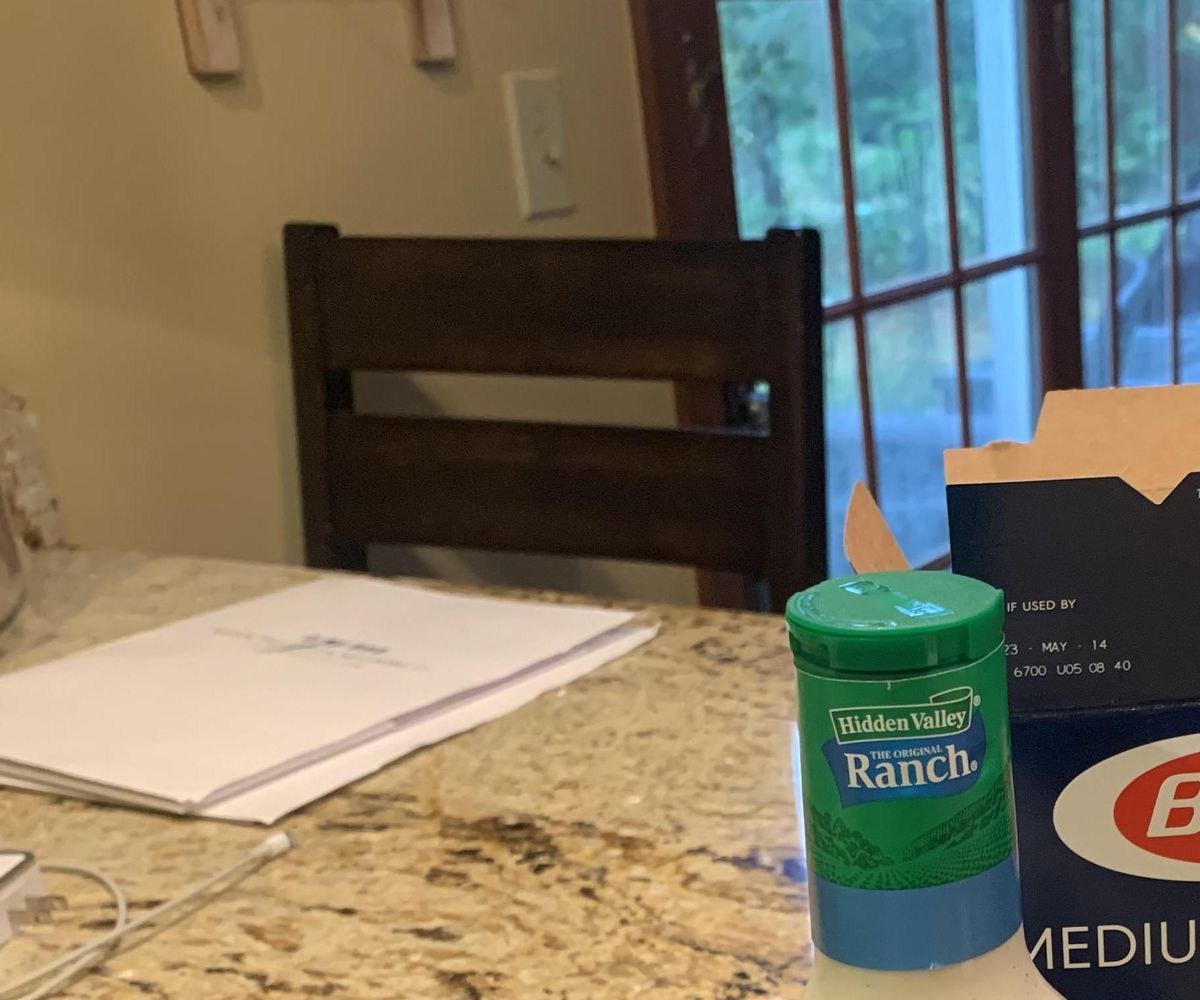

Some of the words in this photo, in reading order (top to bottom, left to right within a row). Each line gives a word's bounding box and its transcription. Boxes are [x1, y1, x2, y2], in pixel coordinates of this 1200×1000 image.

[1006, 602, 1017, 612] IF
[1022, 600, 1056, 612] USED
[1060, 599, 1077, 610] BY
[1004, 643, 1018, 656] 23
[1042, 641, 1068, 654] MAY
[1092, 639, 1107, 651] 14
[1013, 665, 1047, 678] 6700
[838, 712, 909, 736] Hidden
[911, 708, 967, 731] Valley
[870, 750, 892, 761] THE
[893, 744, 943, 759] ORIGINAL
[844, 744, 972, 789] Ranch
